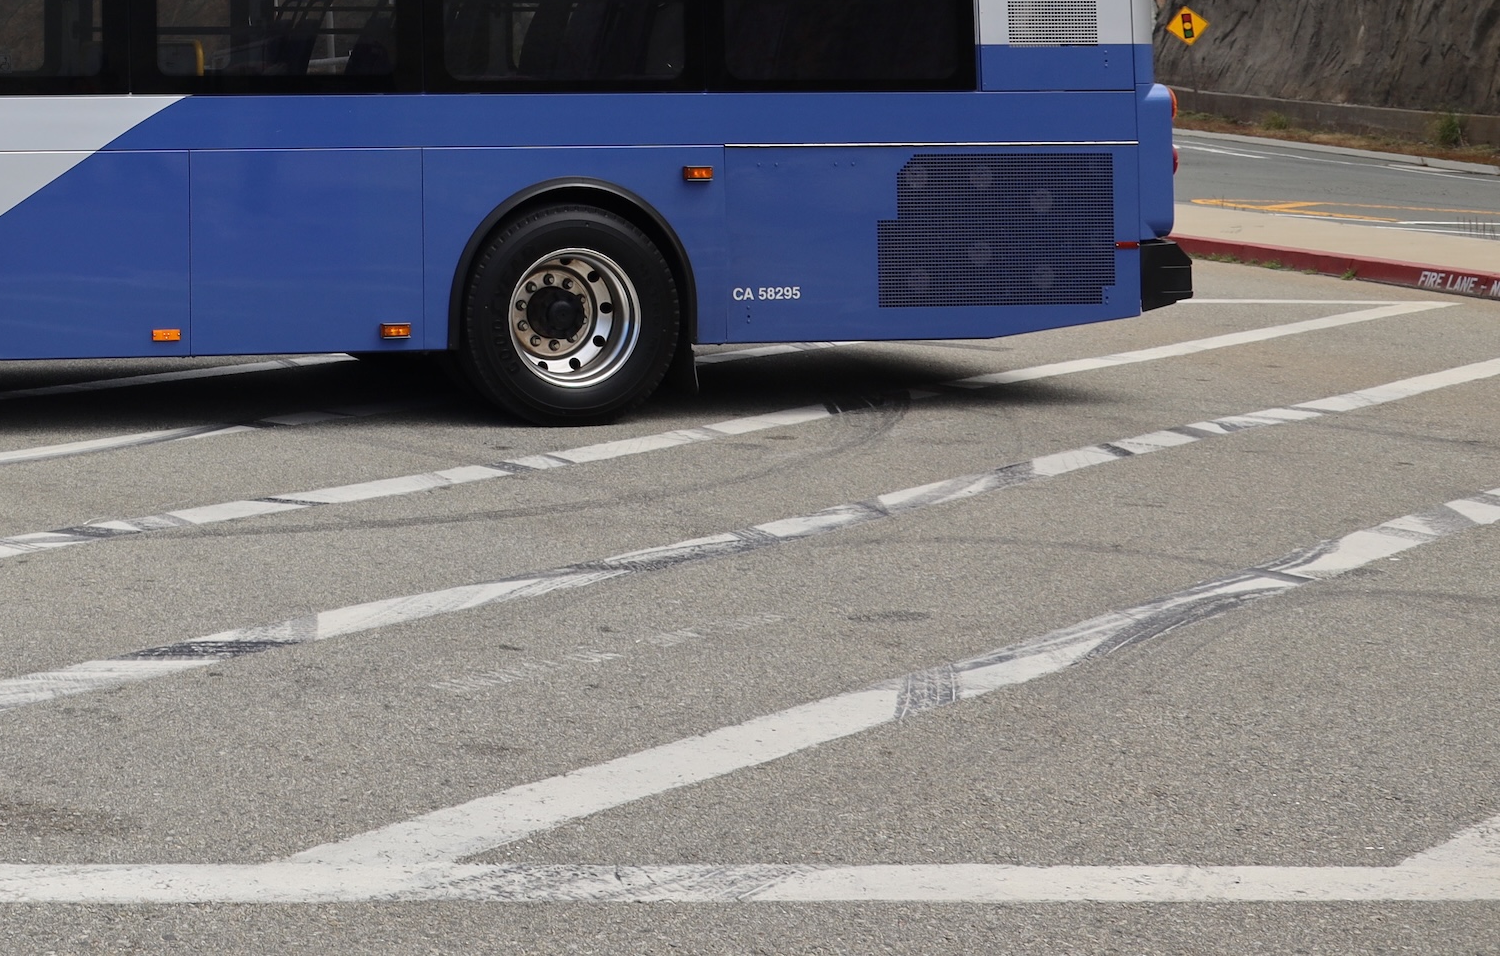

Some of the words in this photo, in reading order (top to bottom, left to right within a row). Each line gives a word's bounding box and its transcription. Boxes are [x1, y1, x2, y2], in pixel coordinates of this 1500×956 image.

[1417, 271, 1446, 289] FIRE
[1445, 274, 1479, 293] LANE
[732, 287, 755, 301] CA
[758, 286, 801, 300] 58295
